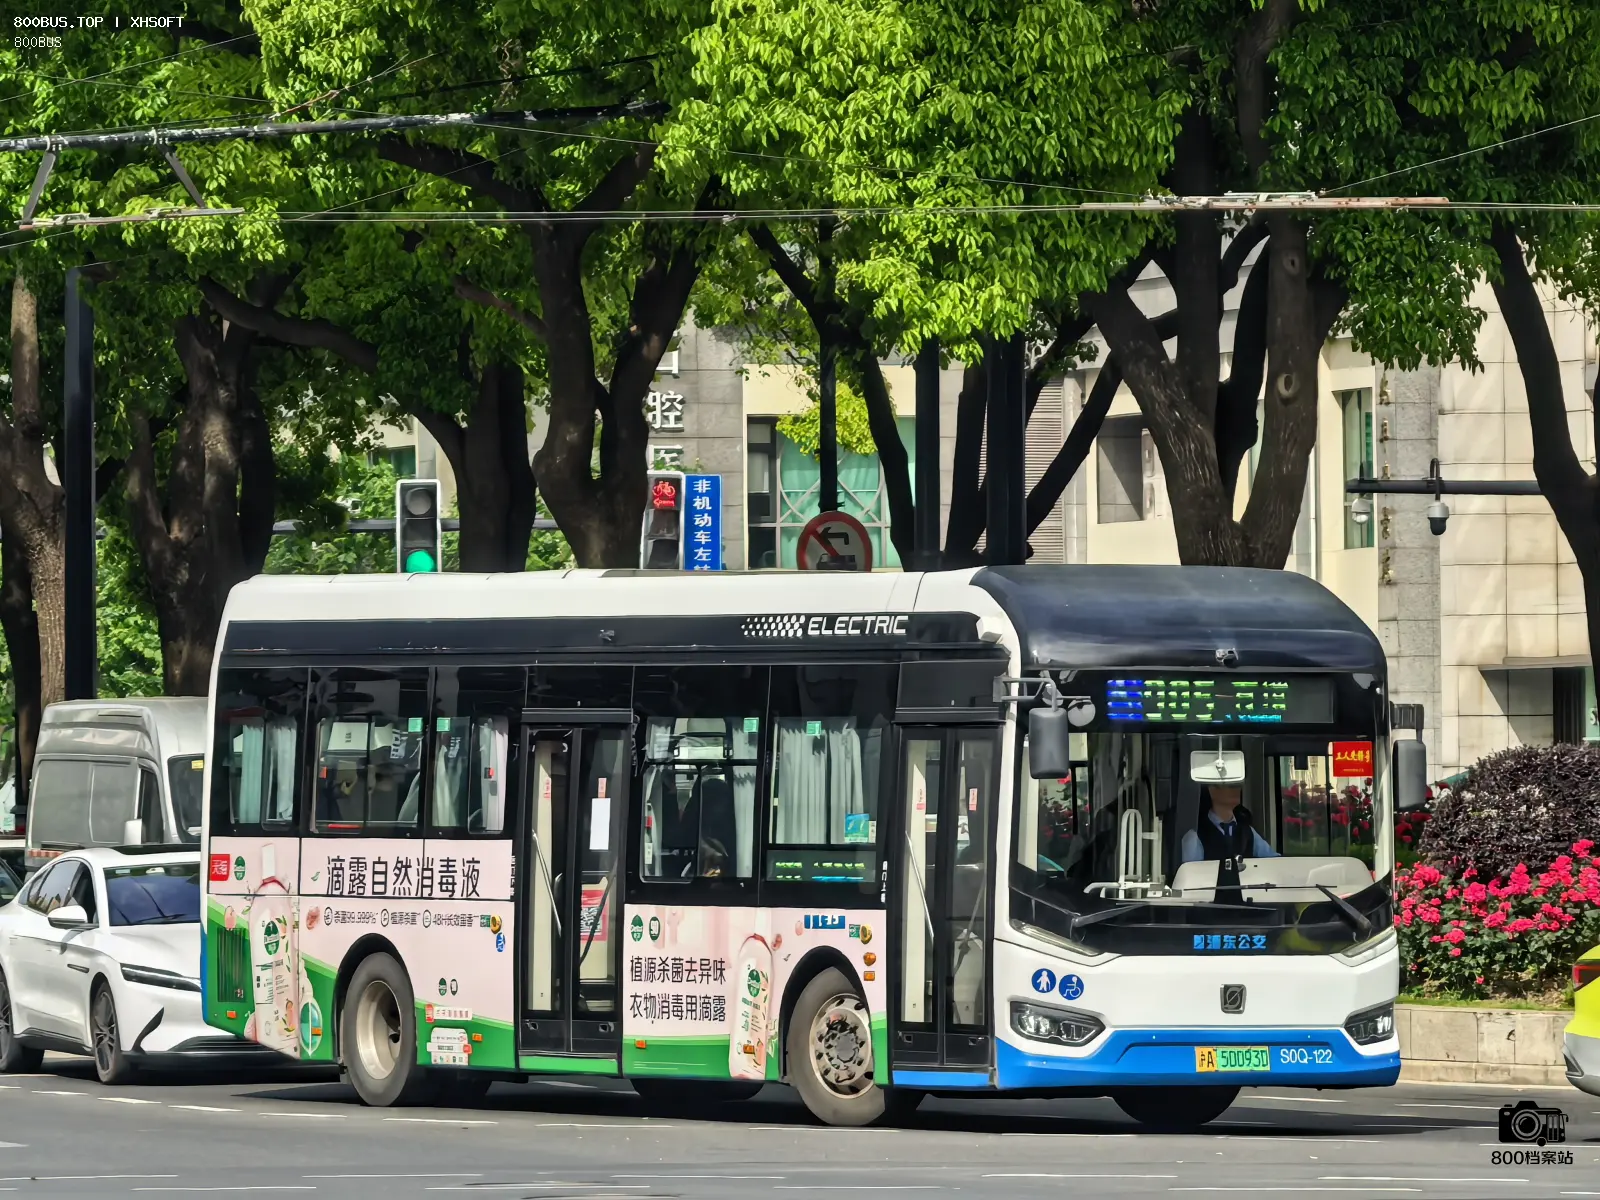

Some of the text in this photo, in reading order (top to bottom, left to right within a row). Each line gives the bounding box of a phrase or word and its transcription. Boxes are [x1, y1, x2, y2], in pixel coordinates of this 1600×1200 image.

[692, 479, 713, 570] 非机动车左
[807, 615, 909, 636] ELECTRIC
[326, 855, 481, 898] 滴露自然消毒液
[630, 956, 727, 985] 植源杀菌去异味
[630, 992, 727, 1022] 衣物消毒用滴露
